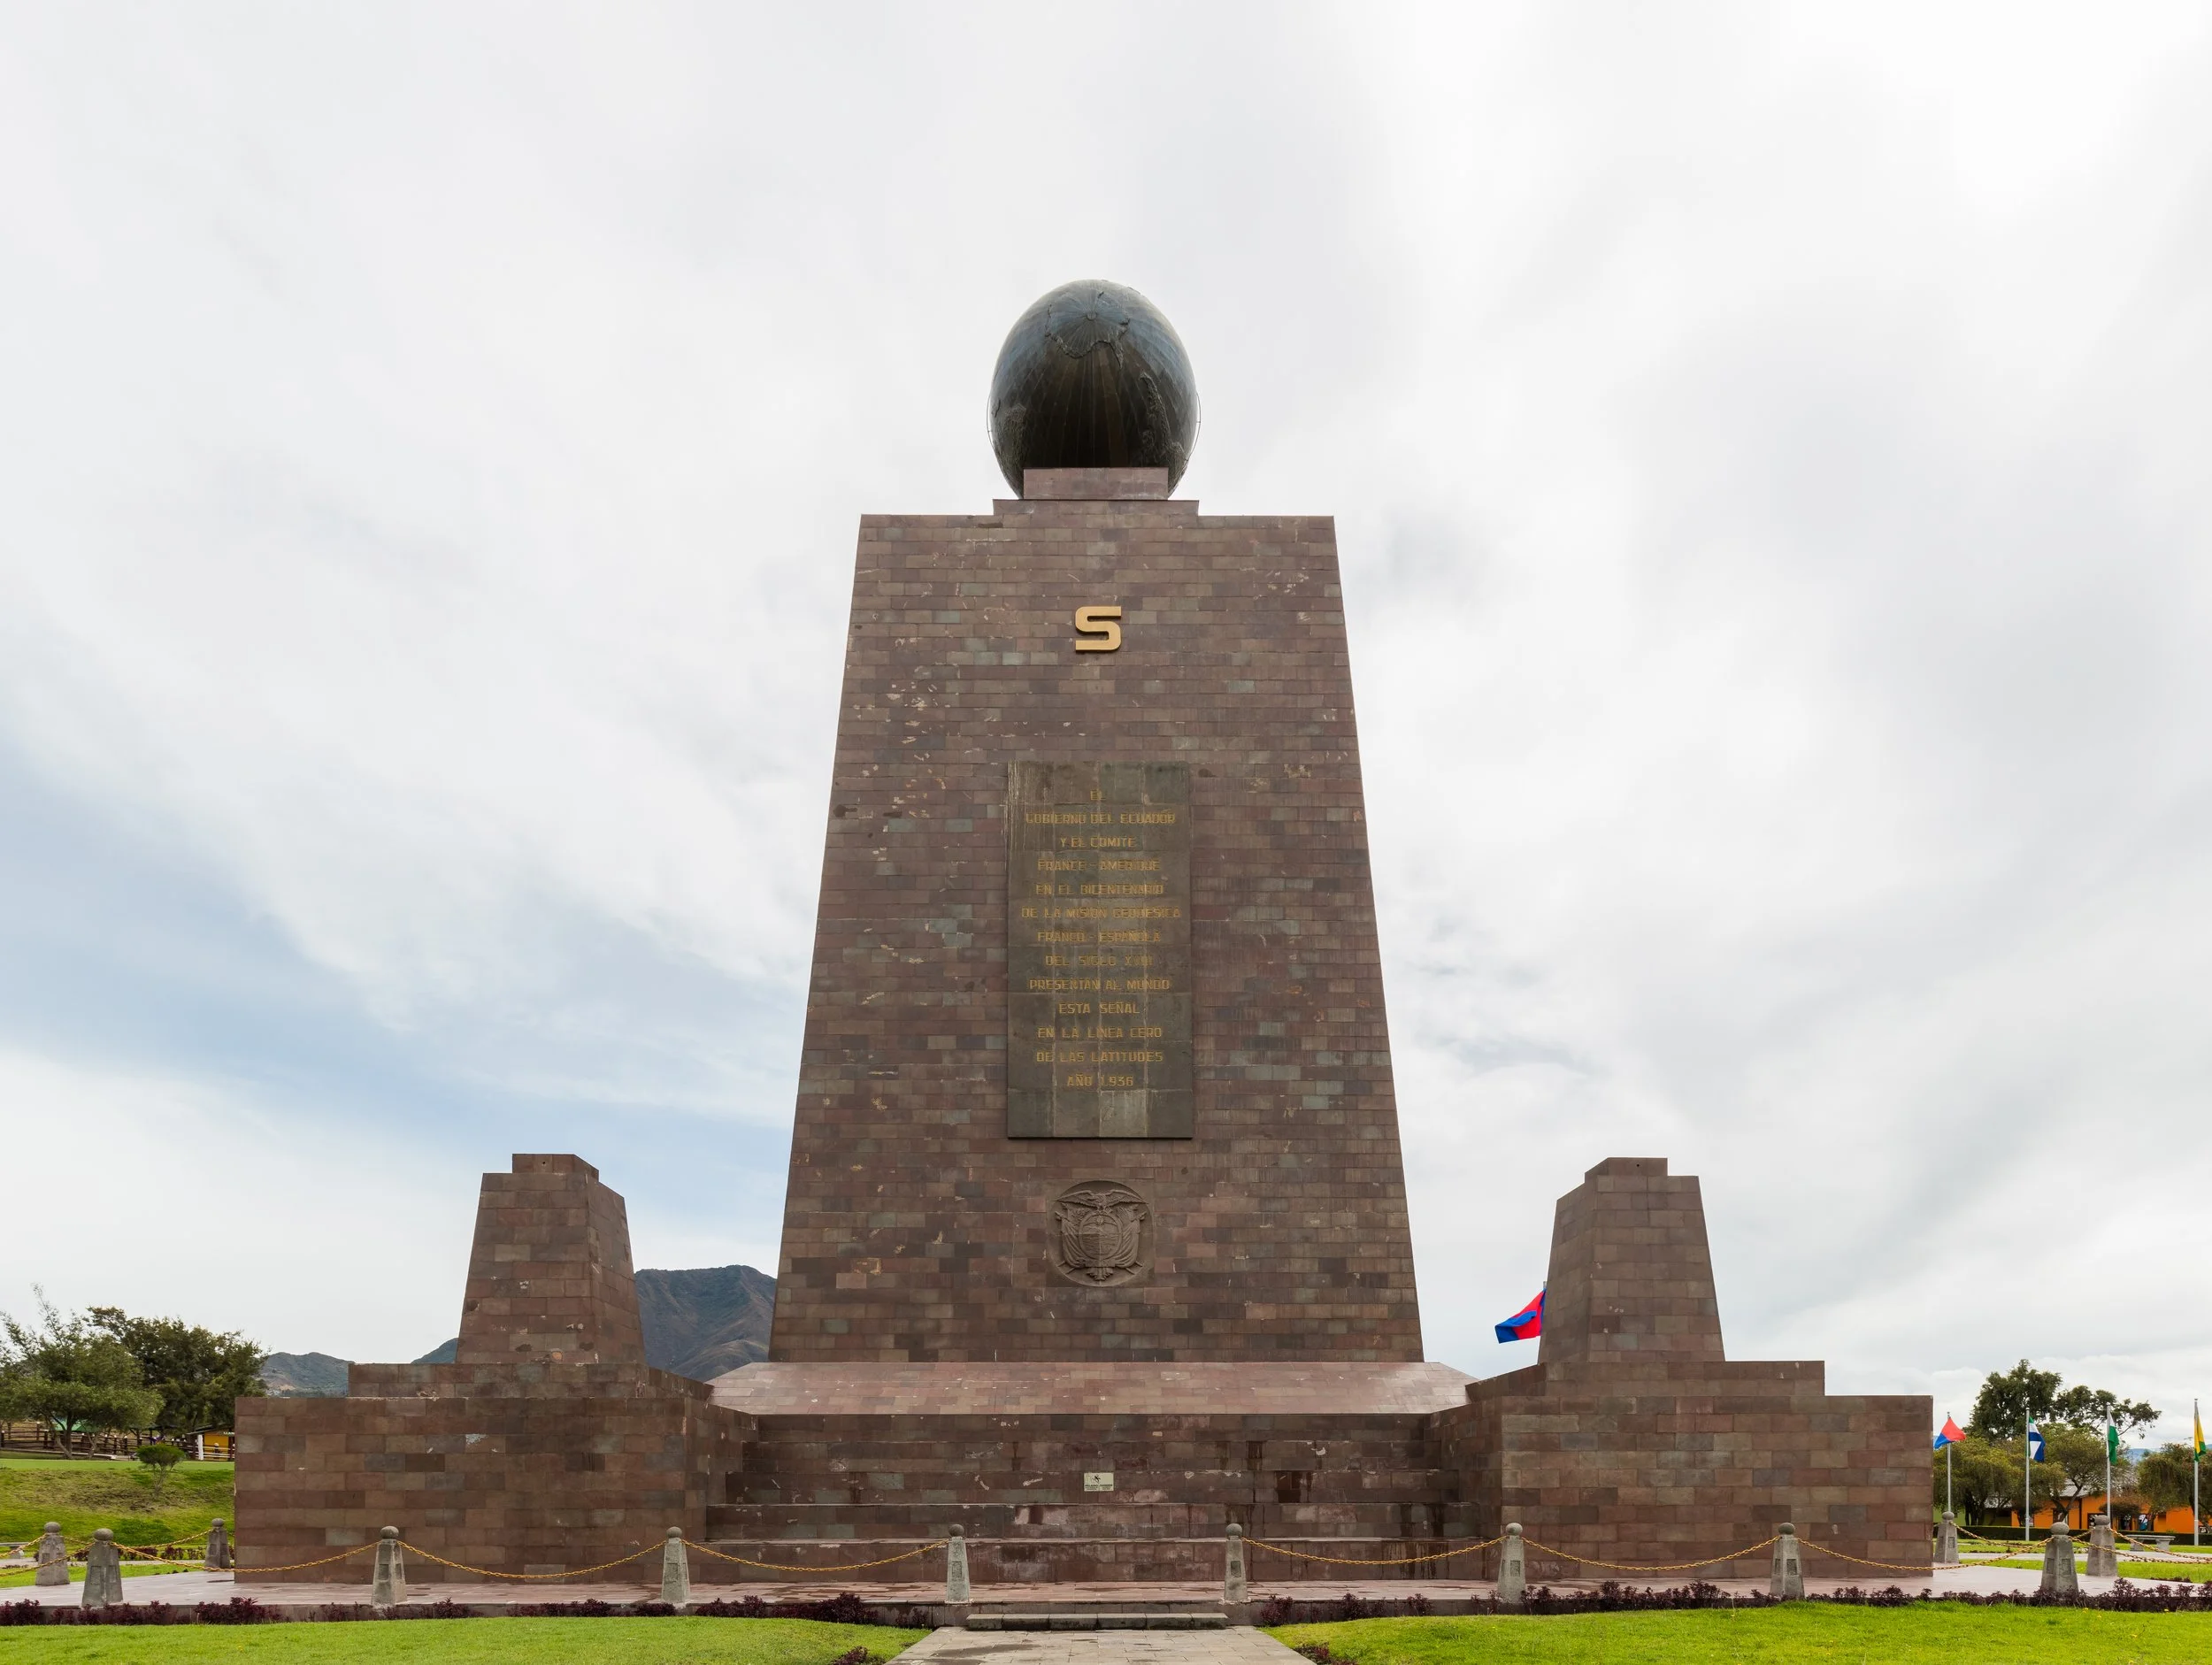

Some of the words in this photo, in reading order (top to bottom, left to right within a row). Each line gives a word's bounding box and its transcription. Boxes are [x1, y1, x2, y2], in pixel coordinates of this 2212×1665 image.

[1075, 606, 1121, 651] S
[1090, 790, 1106, 801] EL
[1090, 812, 1115, 825] DEL
[1120, 812, 1176, 825] ECUADOR
[1060, 837, 1068, 848] Y
[1071, 837, 1086, 848] EL
[1090, 836, 1137, 848] COMITE
[1037, 859, 1087, 871] FRANCE
[1100, 859, 1161, 871] AMERIQUE
[1036, 884, 1052, 895] EN
[1058, 884, 1074, 895] EL
[1080, 884, 1164, 895] BICENTENARIO
[1021, 907, 1037, 918] DE
[1044, 907, 1061, 918] LA
[1037, 931, 1085, 942] FRANCO
[1098, 930, 1161, 942] ESPAÑOLA
[1045, 955, 1070, 966] DEL
[1079, 955, 1117, 966] SIGLO
[1029, 978, 1101, 990] PRESENTAN
[1105, 978, 1121, 990] AL
[1126, 978, 1171, 990] MUNDO
[1058, 1002, 1091, 1014] ESTA
[1099, 1001, 1141, 1014] SEÑAL
[1037, 1027, 1054, 1039] EN
[1062, 1027, 1079, 1039] LA
[1130, 1027, 1162, 1039] CERO
[1036, 1051, 1054, 1063] DE
[1060, 1051, 1084, 1063] LAS
[1091, 1051, 1164, 1063] LATITUDES
[1067, 1073, 1093, 1086] AÑO
